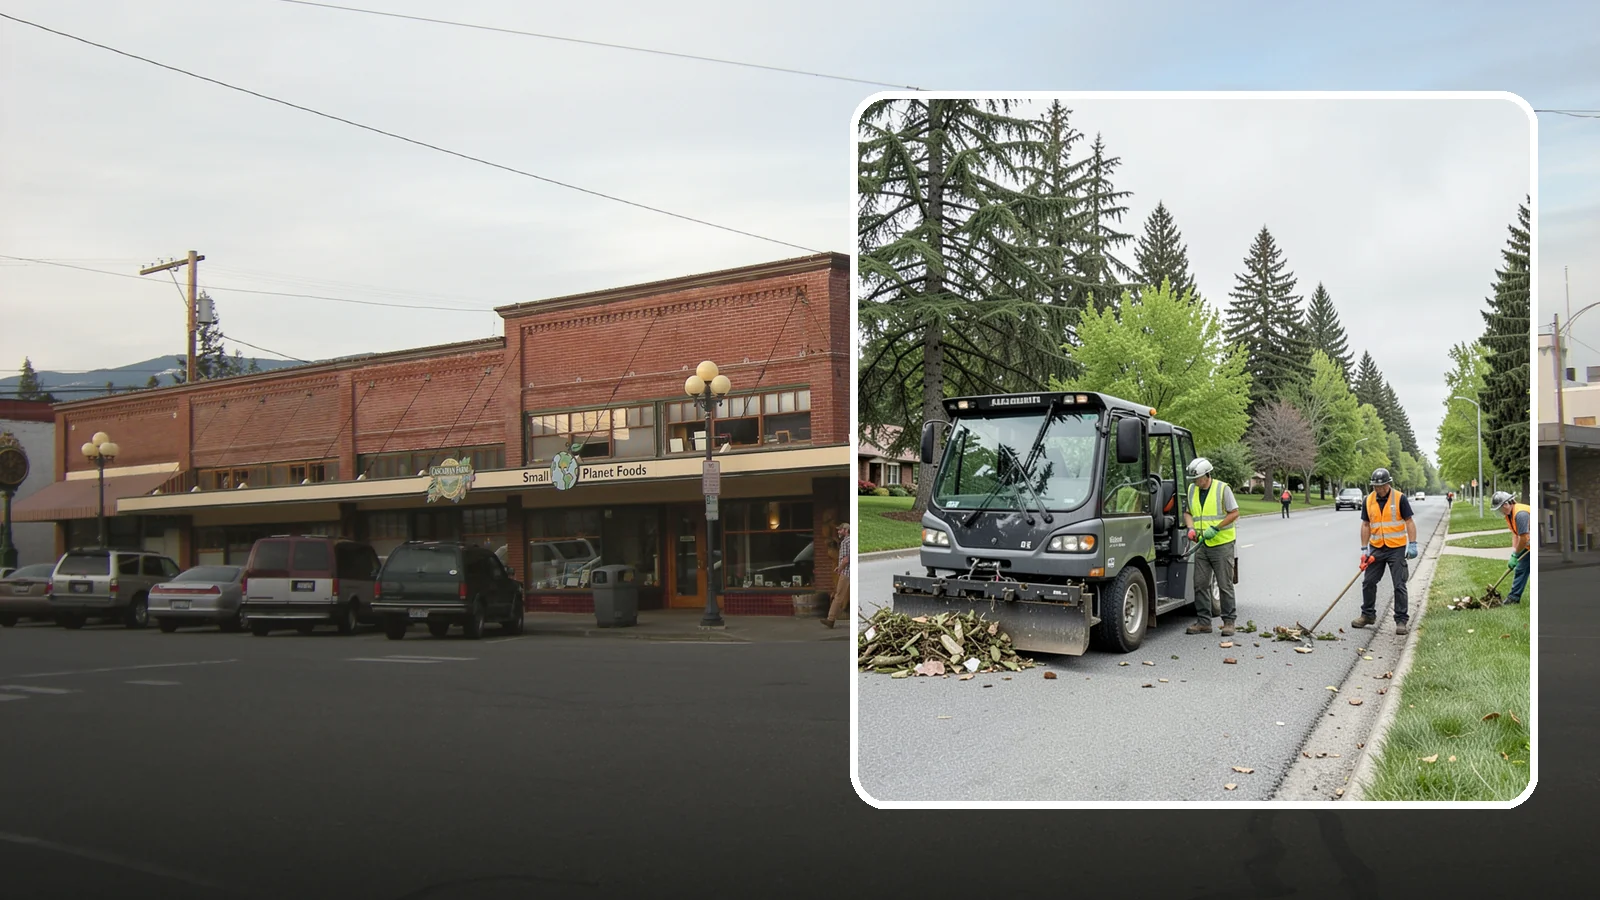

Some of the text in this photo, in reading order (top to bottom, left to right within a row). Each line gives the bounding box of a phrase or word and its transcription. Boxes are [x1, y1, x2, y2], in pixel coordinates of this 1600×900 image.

[523, 464, 647, 483] Small Planet Foods
